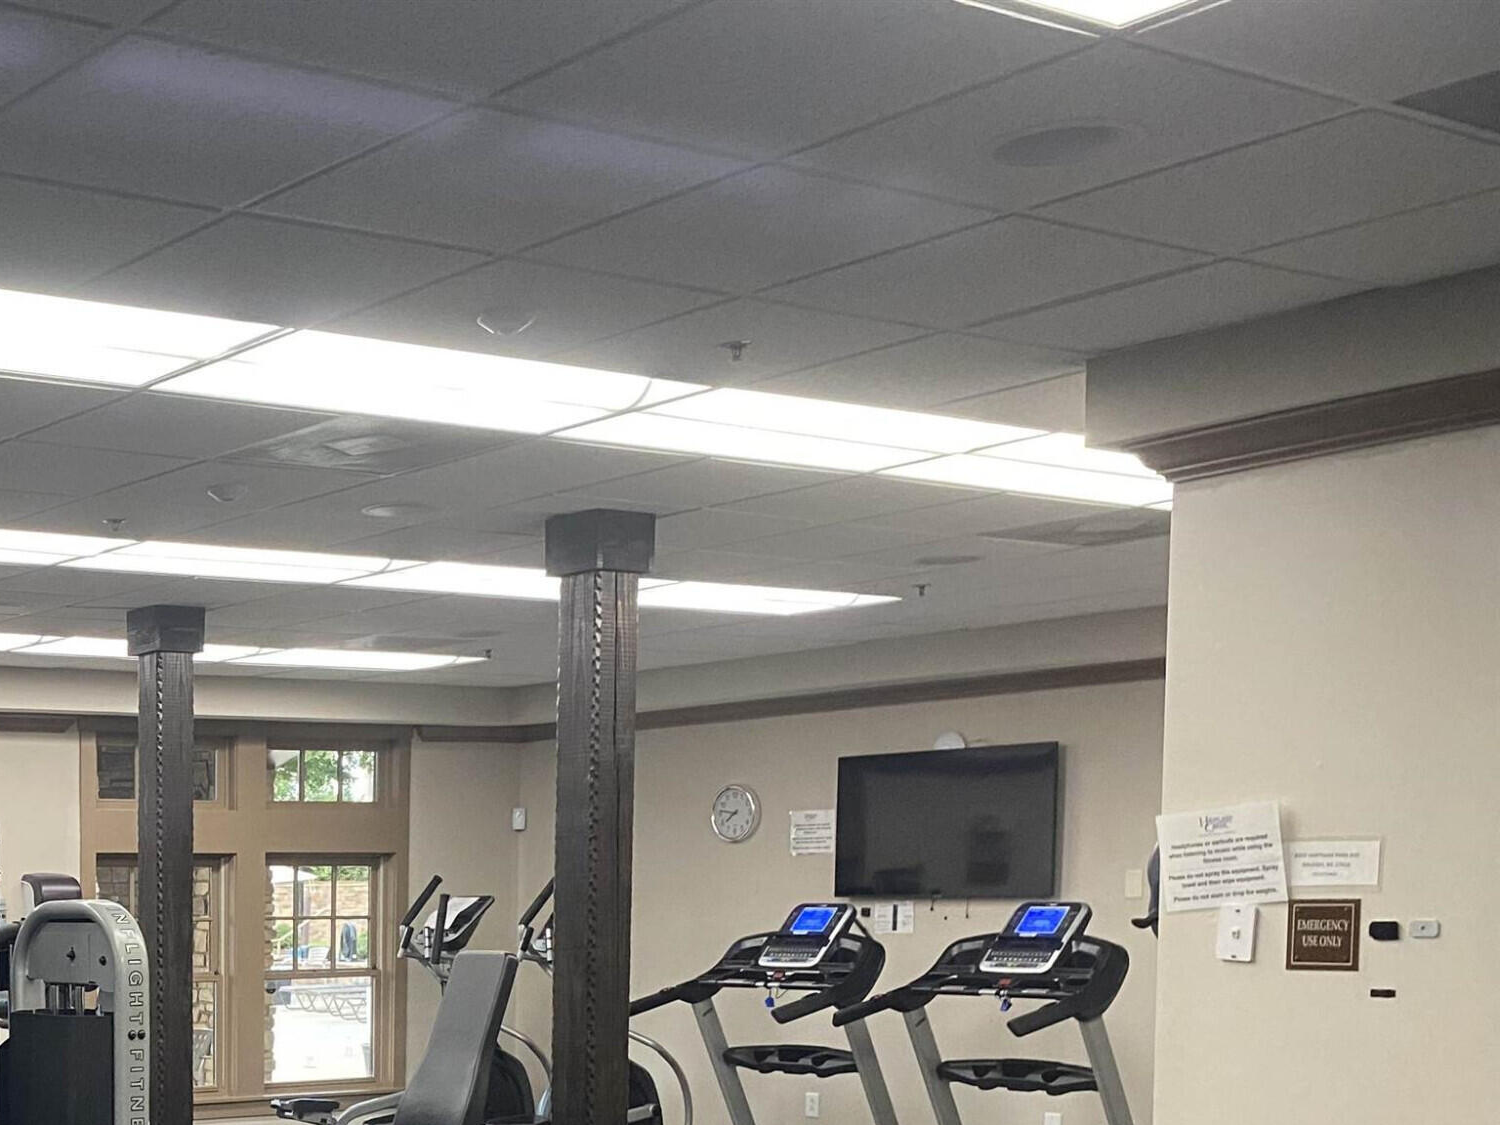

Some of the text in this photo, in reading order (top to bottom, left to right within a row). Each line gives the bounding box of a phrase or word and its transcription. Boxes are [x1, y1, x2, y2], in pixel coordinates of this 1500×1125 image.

[1297, 919, 1349, 931] EMERGENCY
[1302, 935, 1343, 947] USE ONLY
[107, 906, 144, 1025] INFLIGHT
